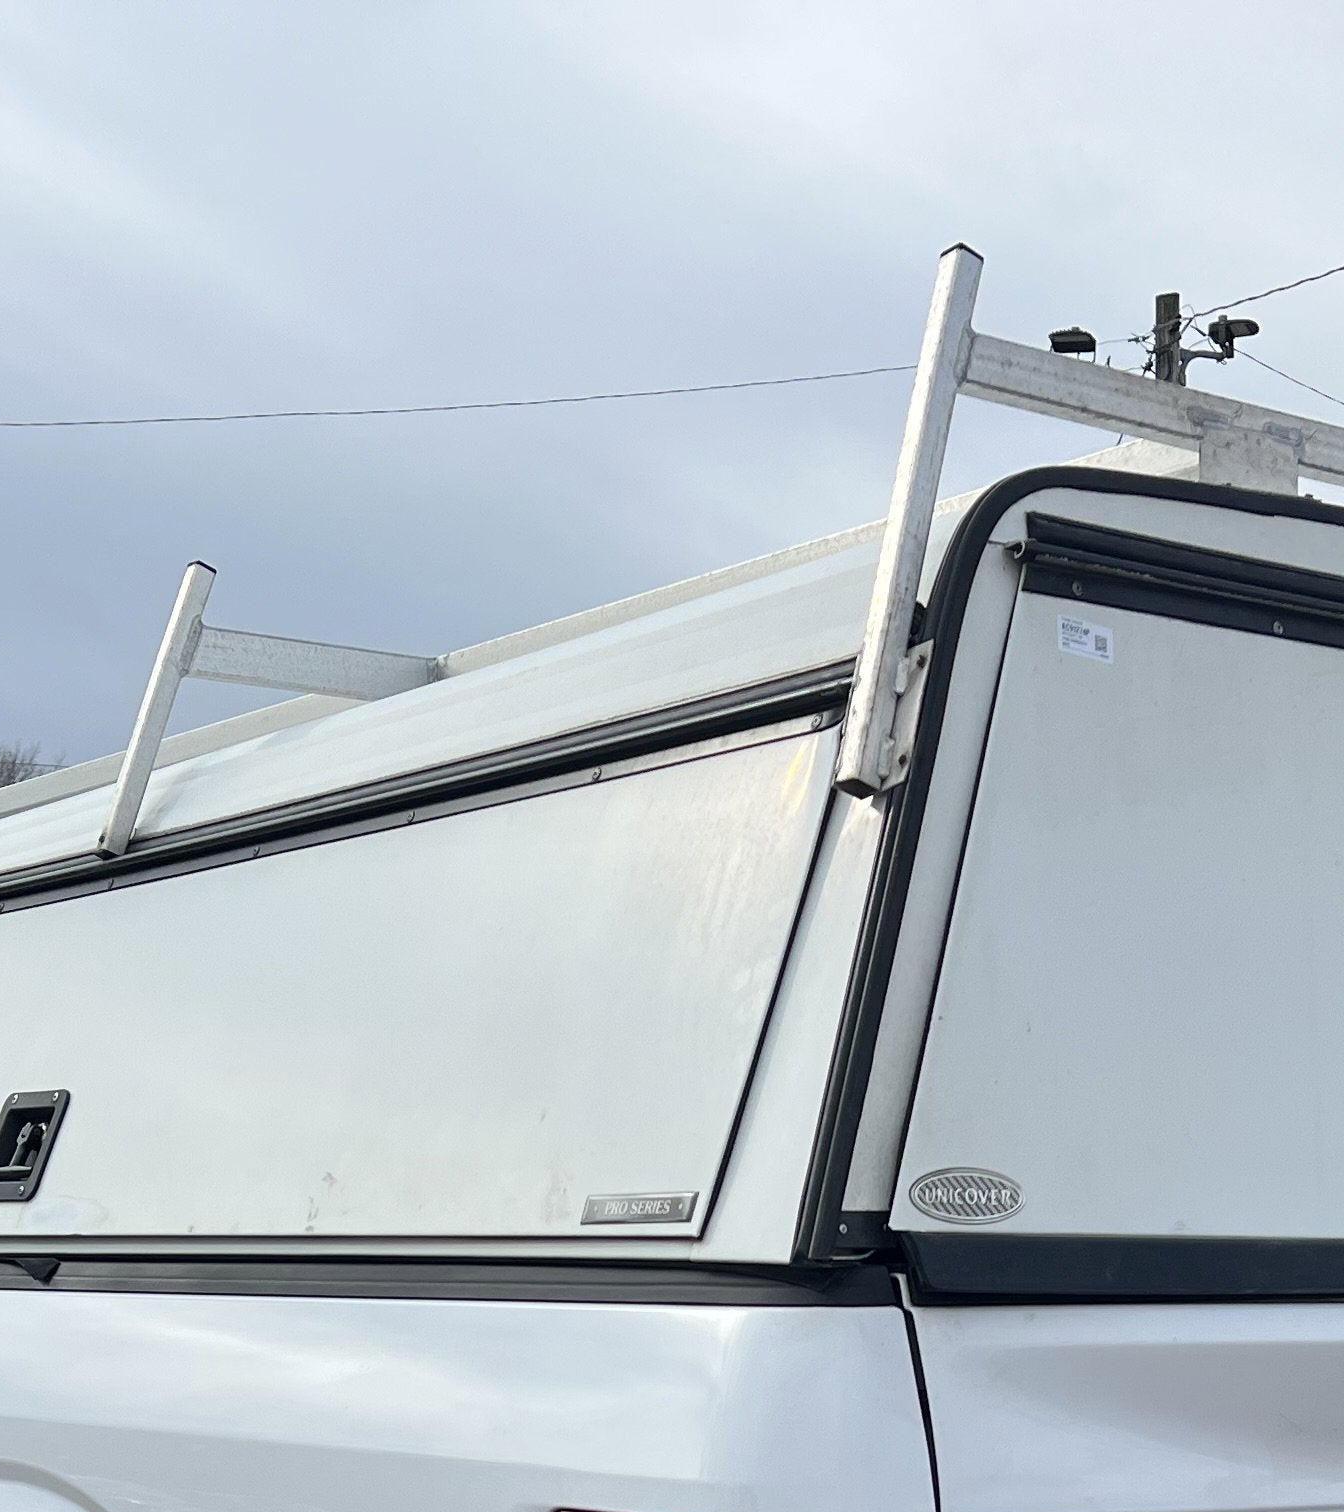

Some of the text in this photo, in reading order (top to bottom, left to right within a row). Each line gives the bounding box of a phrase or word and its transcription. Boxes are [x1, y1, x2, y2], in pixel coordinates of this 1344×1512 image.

[925, 1187, 1012, 1206] UNICOVER
[604, 1199, 671, 1215] PRO SERIES
